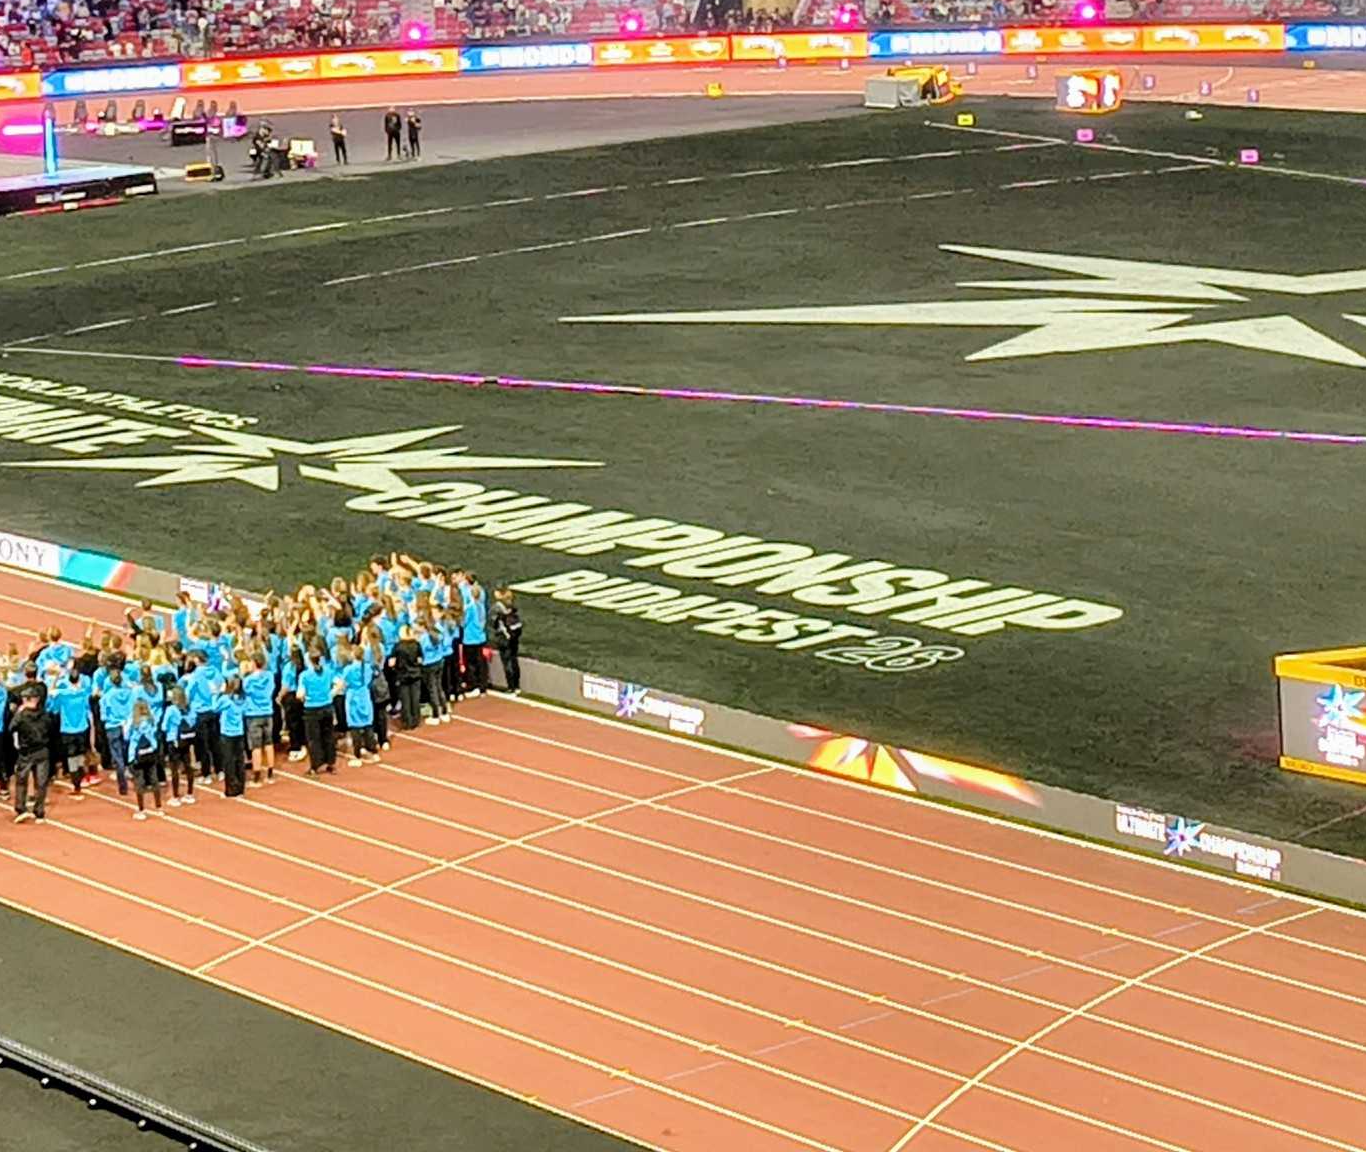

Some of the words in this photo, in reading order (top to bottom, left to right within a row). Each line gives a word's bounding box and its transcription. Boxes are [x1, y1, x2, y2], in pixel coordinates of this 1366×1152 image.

[68, 391, 259, 430] ATHLETICS
[345, 481, 1124, 636] CHAMPIONSHIP
[507, 568, 877, 650] BUDAPEST
[814, 636, 965, 671] 26
